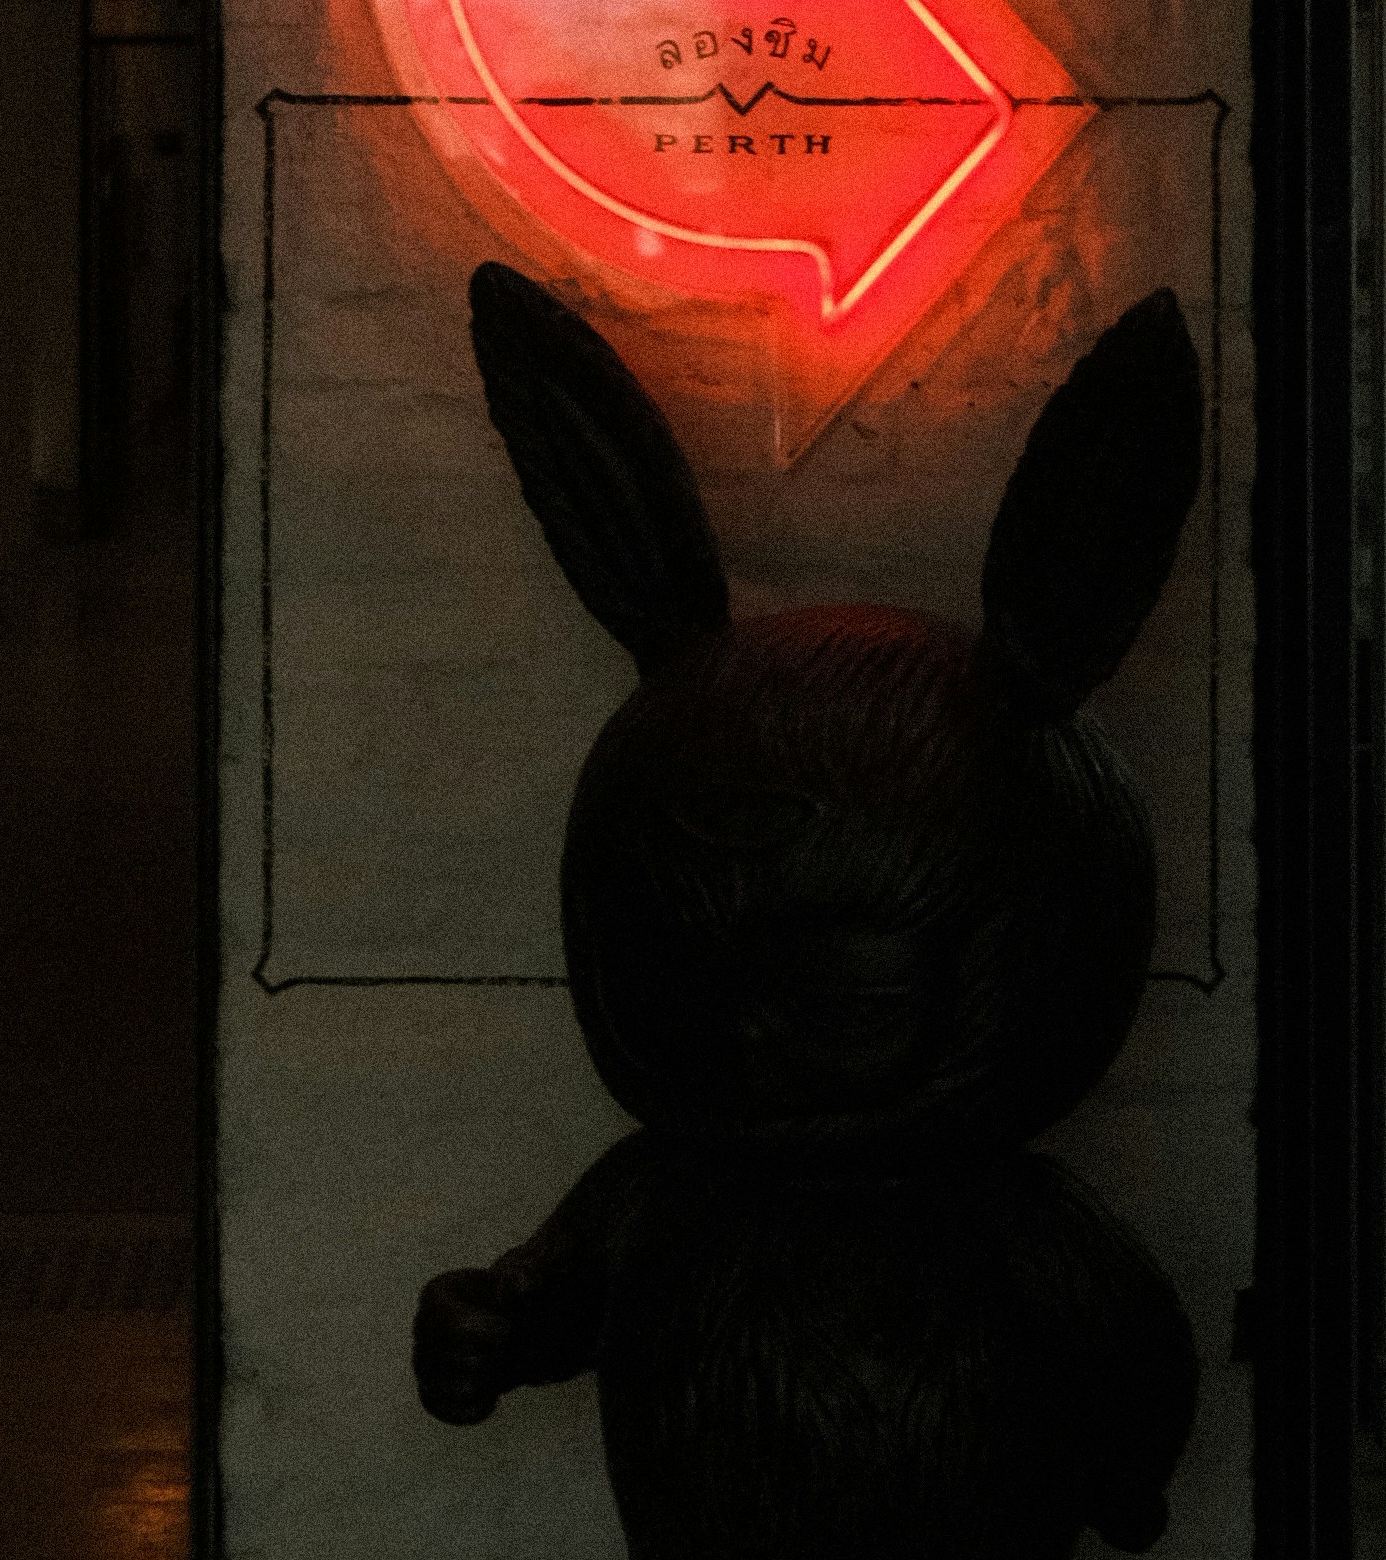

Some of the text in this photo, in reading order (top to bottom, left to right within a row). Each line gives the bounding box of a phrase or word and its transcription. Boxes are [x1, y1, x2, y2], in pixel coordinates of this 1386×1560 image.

[656, 17, 831, 71] ลองชิม
[653, 133, 832, 156] PERTH
